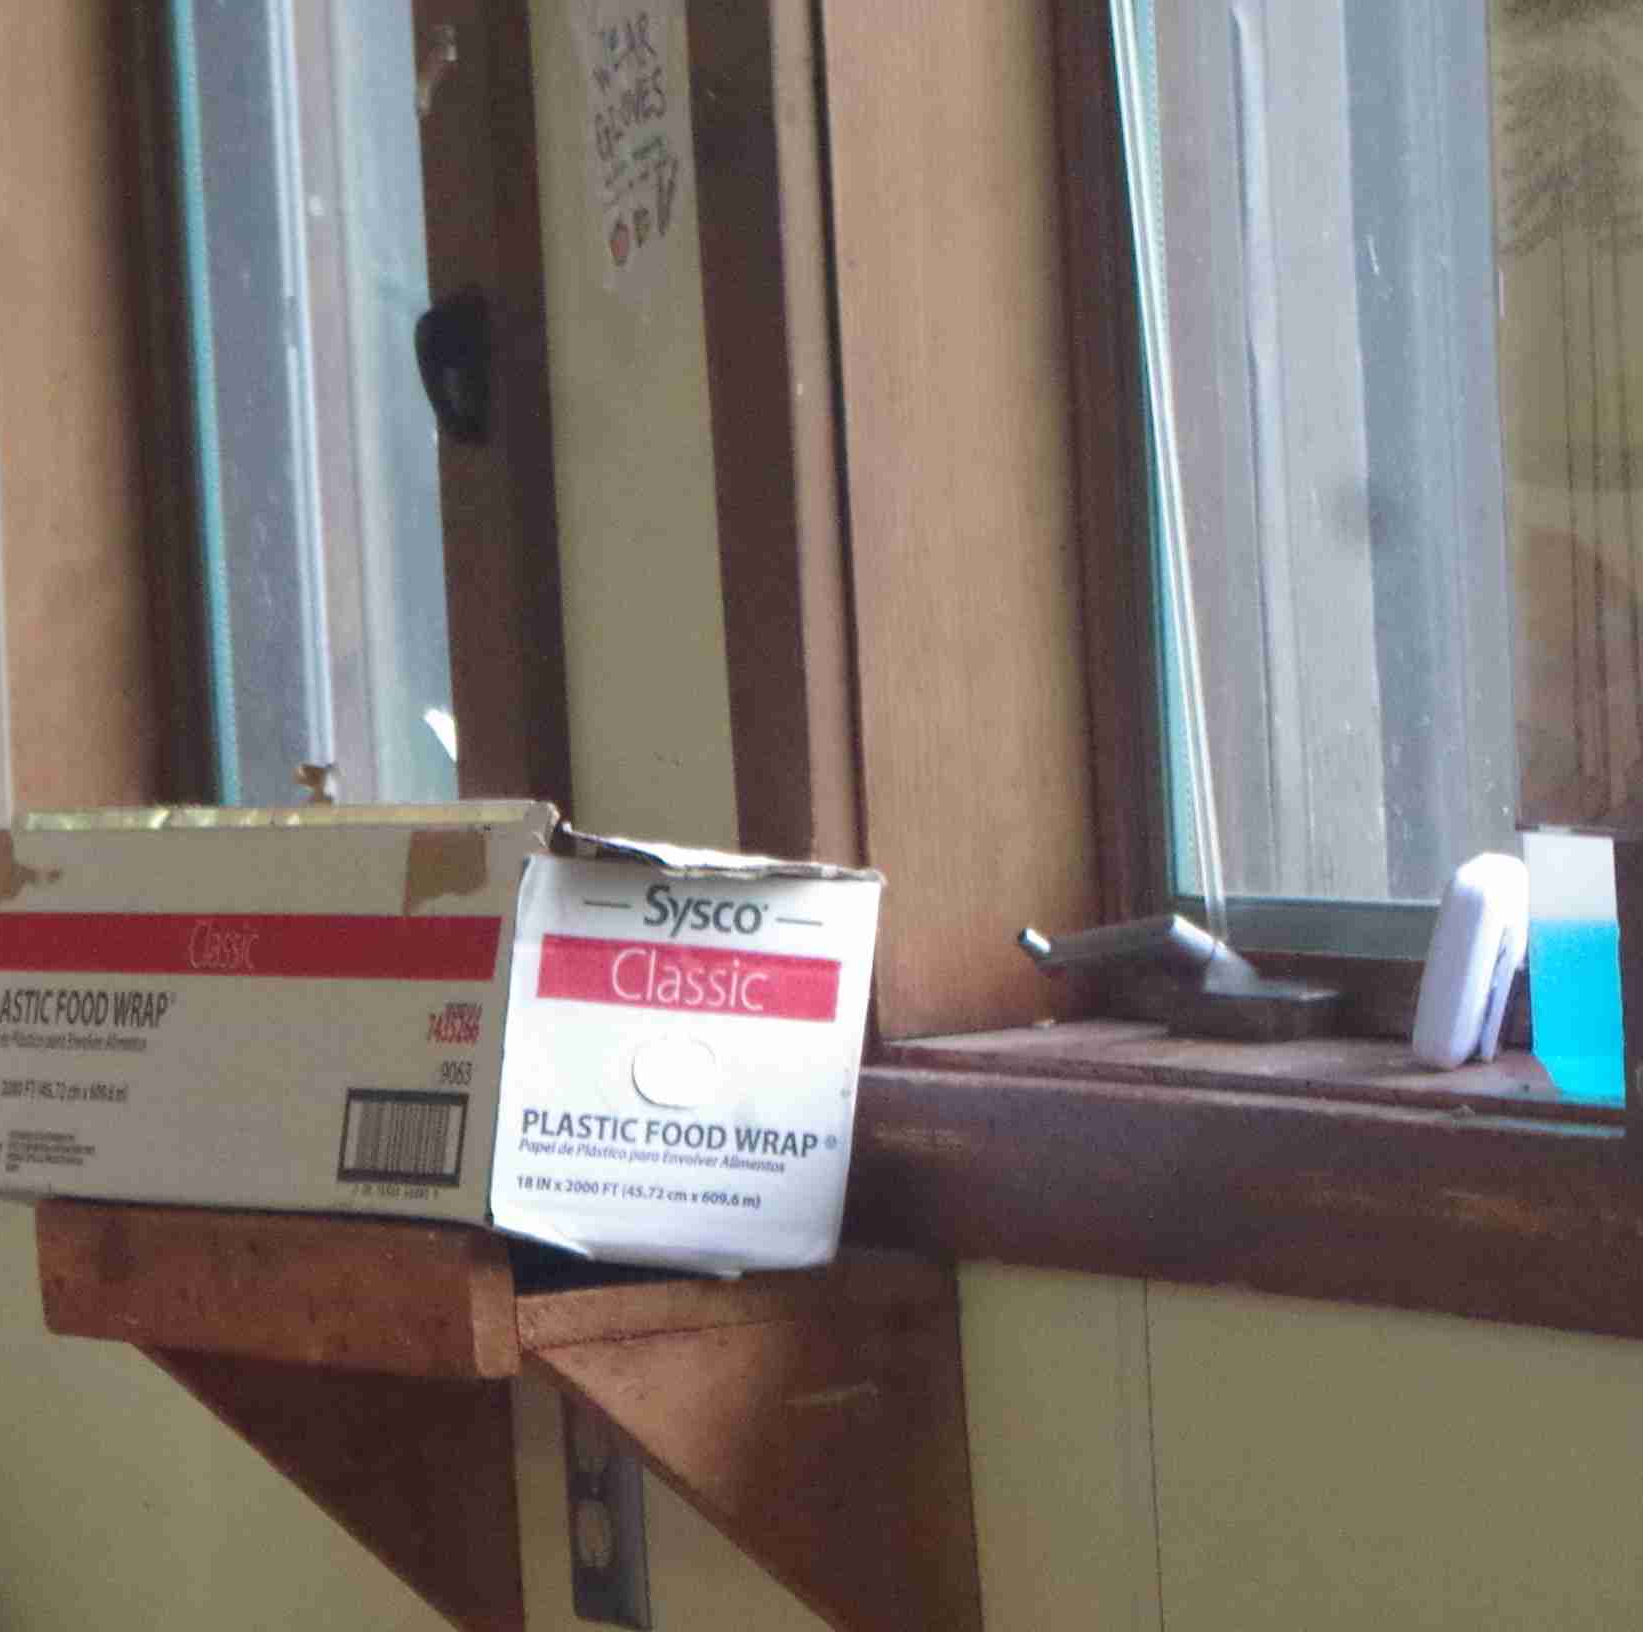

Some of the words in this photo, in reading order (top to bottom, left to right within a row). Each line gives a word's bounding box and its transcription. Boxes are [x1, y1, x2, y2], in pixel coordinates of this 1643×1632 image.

[643, 884, 763, 938] Sysco
[187, 919, 259, 971] Classic
[612, 947, 770, 1011] Classic
[56, 990, 109, 1026] FOOD
[114, 991, 170, 1029] WRAP
[518, 1138, 556, 1155] Papel
[557, 1141, 574, 1155] de
[628, 1148, 660, 1165] para
[662, 1149, 718, 1168] Envolver
[720, 1154, 785, 1173] Alimentos
[522, 1108, 637, 1144] PLASTIC
[645, 1119, 726, 1150] FOOD
[735, 1128, 818, 1158] WRAP
[517, 1175, 532, 1190] 18
[536, 1177, 551, 1192] IN
[564, 1178, 600, 1195] 2000
[603, 1181, 619, 1196] FT
[621, 1182, 664, 1201] (45.72
[667, 1189, 689, 1202] cm
[701, 1190, 740, 1207] 609.6
[742, 1193, 762, 1210] m)
